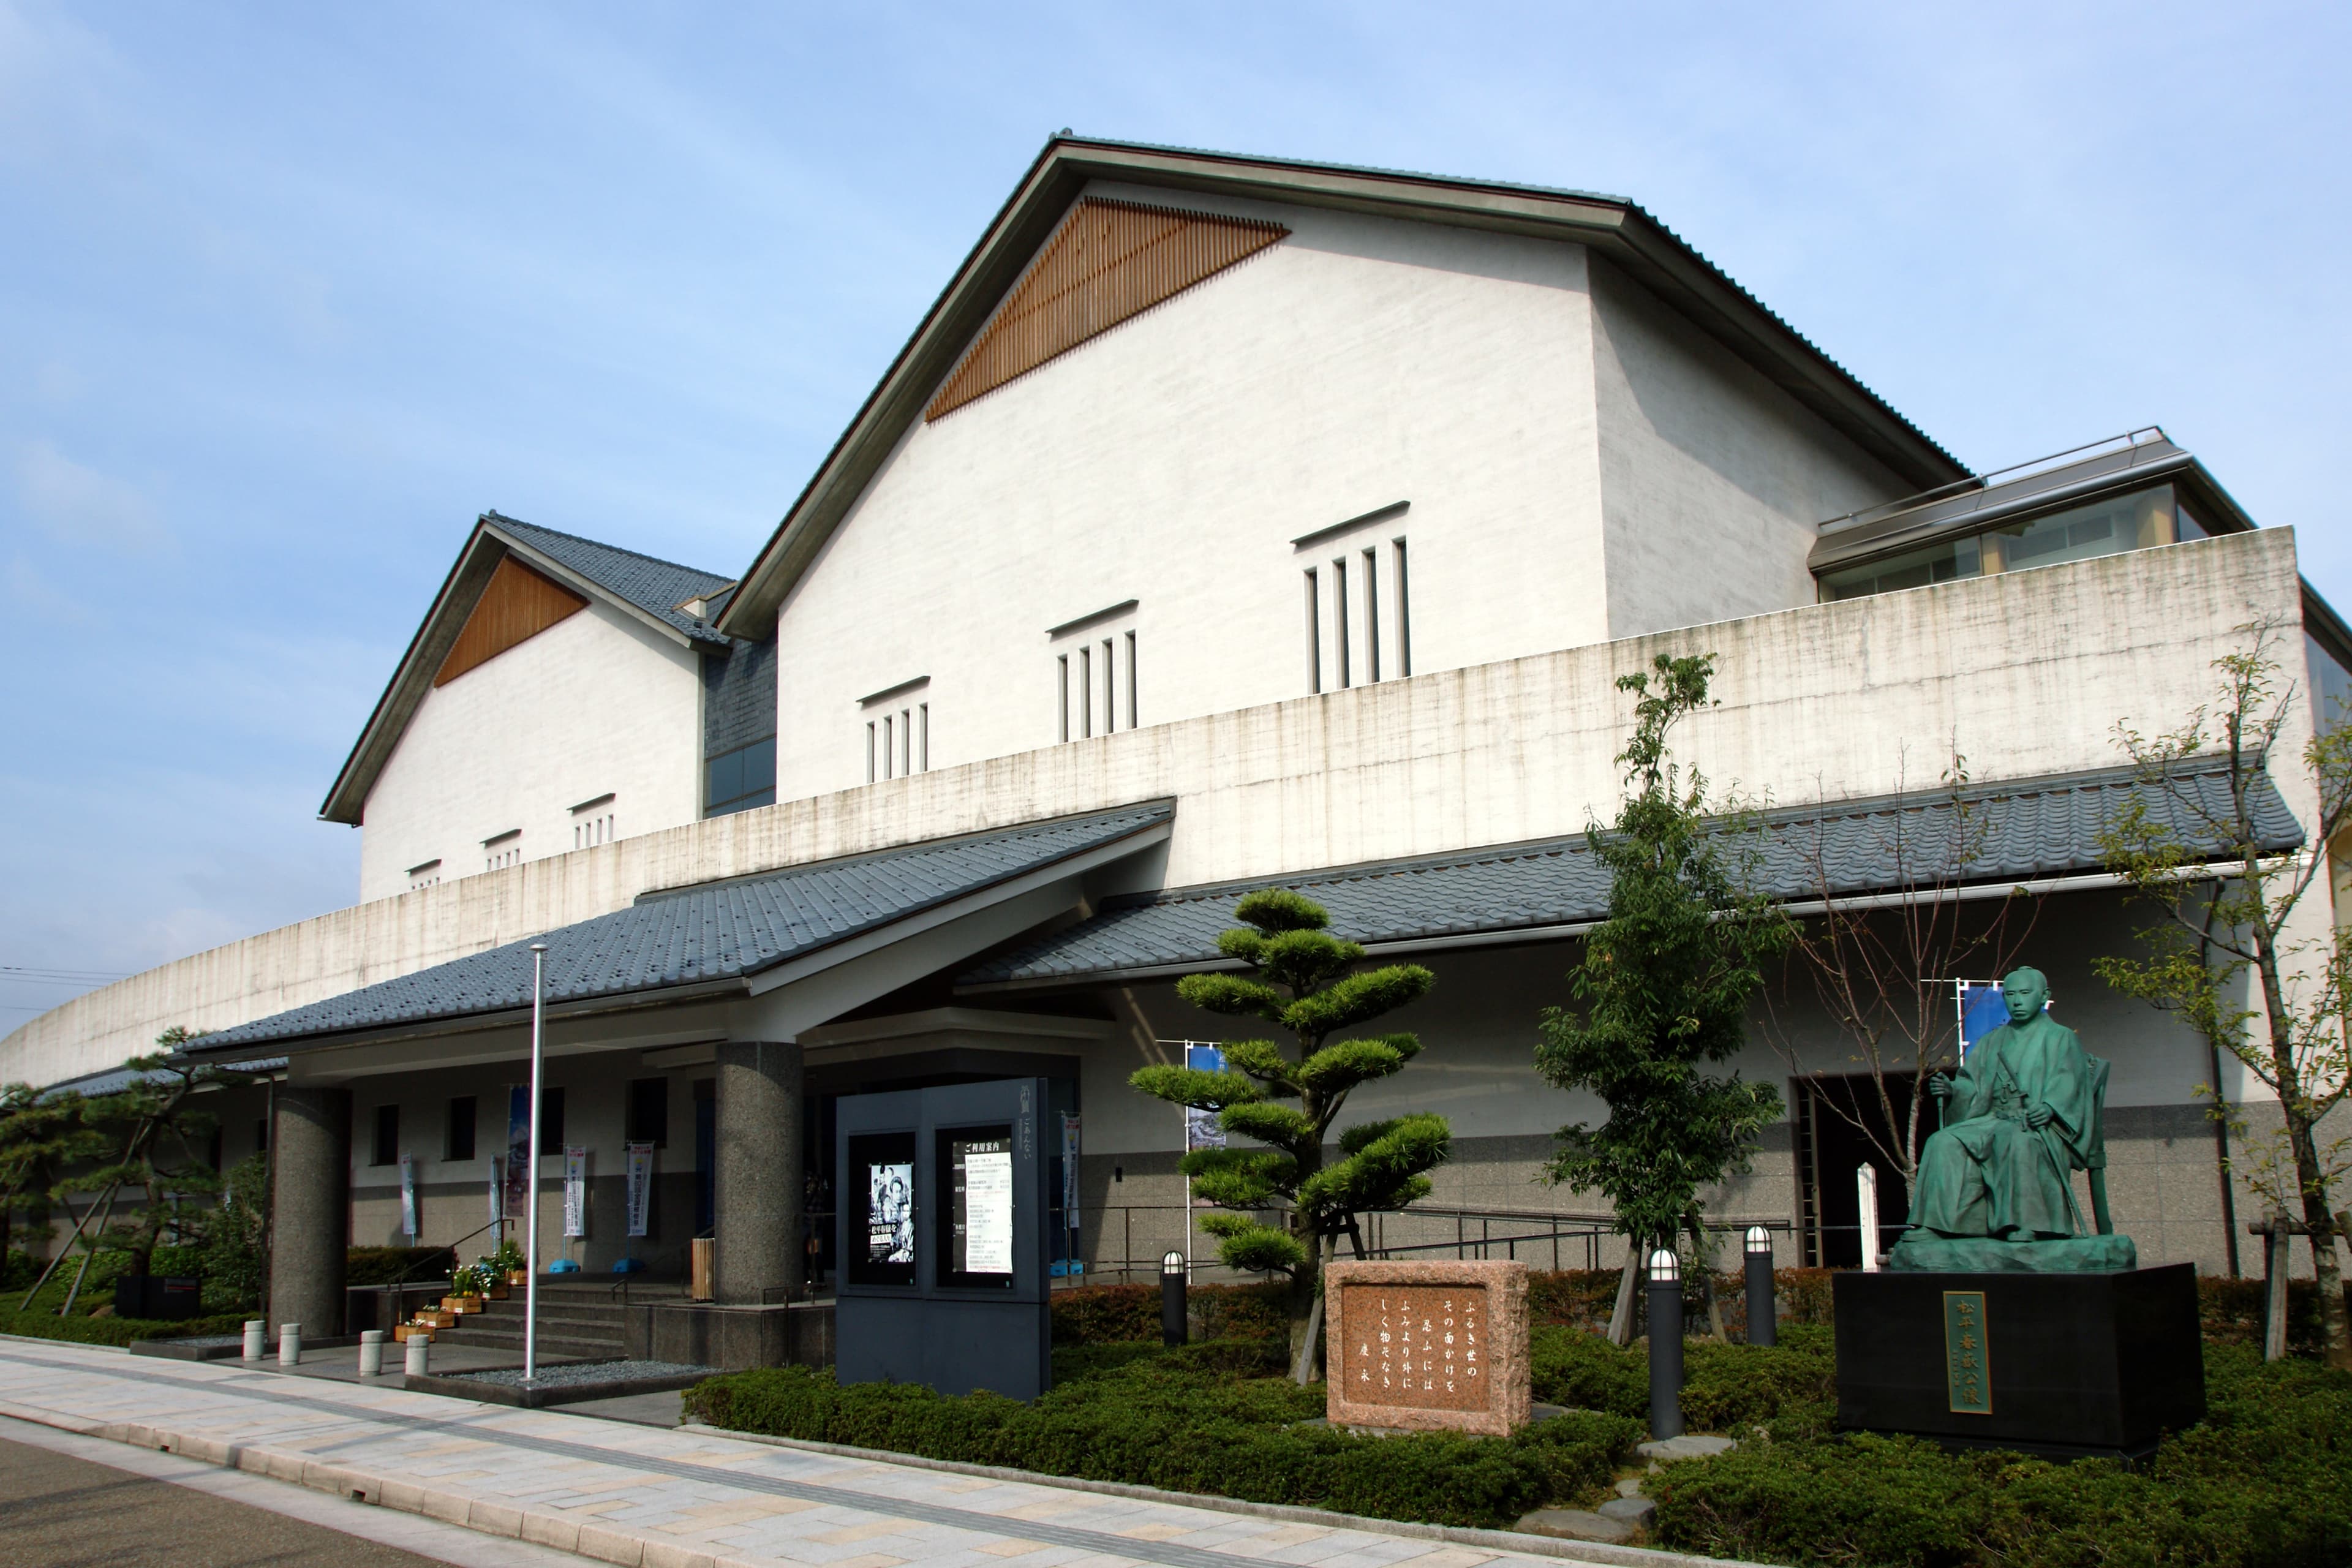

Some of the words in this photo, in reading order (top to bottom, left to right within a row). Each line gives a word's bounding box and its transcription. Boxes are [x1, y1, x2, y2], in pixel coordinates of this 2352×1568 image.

[965, 1141, 1000, 1153] ご利用案内
[1380, 1298, 1390, 1388] しく物そなき
[1401, 1300, 1412, 1389] ふみより外に
[1422, 1319, 1433, 1390] 忍ふには
[1444, 1300, 1454, 1392] その面かけを
[1465, 1302, 1477, 1376] ふるき世の
